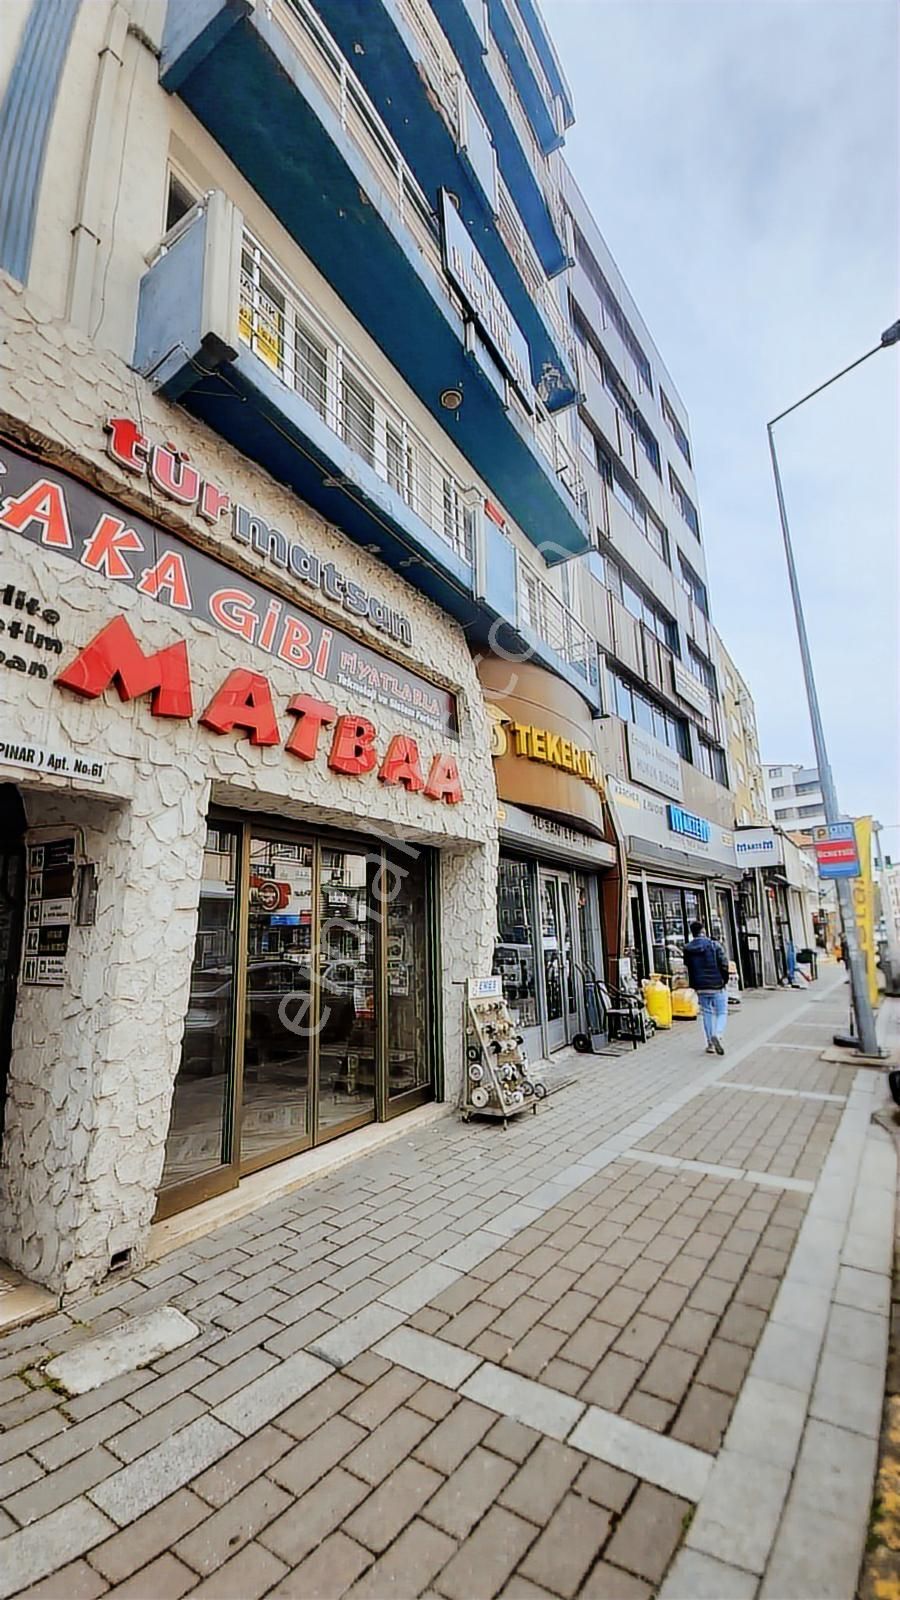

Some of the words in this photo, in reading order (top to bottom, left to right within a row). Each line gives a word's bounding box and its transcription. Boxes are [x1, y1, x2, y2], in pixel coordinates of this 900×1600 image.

[0, 461, 192, 610] AKA
[0, 584, 60, 624] lite
[54, 613, 464, 804] MATBAA
[47, 754, 69, 771] Apt.
